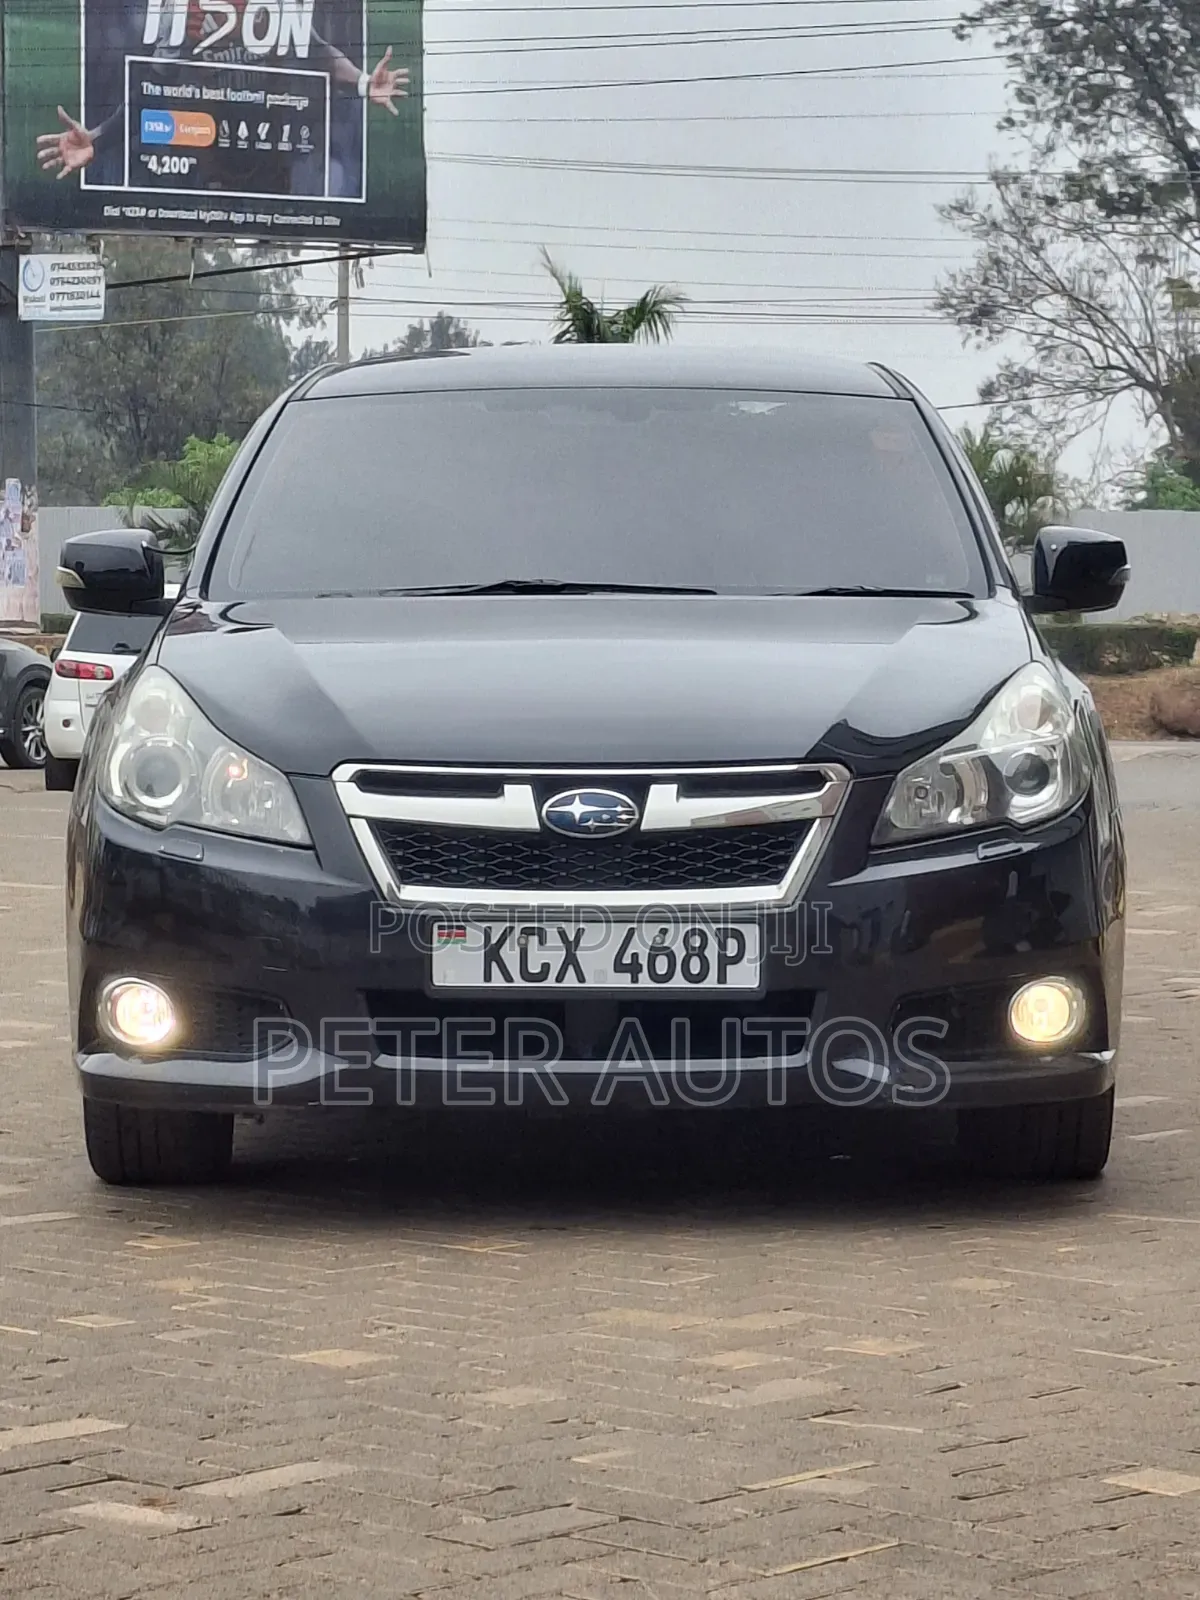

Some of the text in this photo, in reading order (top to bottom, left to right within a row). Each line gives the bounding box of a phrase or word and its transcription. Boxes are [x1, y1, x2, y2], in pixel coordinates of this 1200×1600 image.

[141, 82, 162, 96] The
[163, 84, 200, 99] world's
[202, 86, 225, 100] best
[226, 88, 265, 104] football
[147, 154, 191, 175] 4,200
[483, 925, 747, 985] KCX 468P
